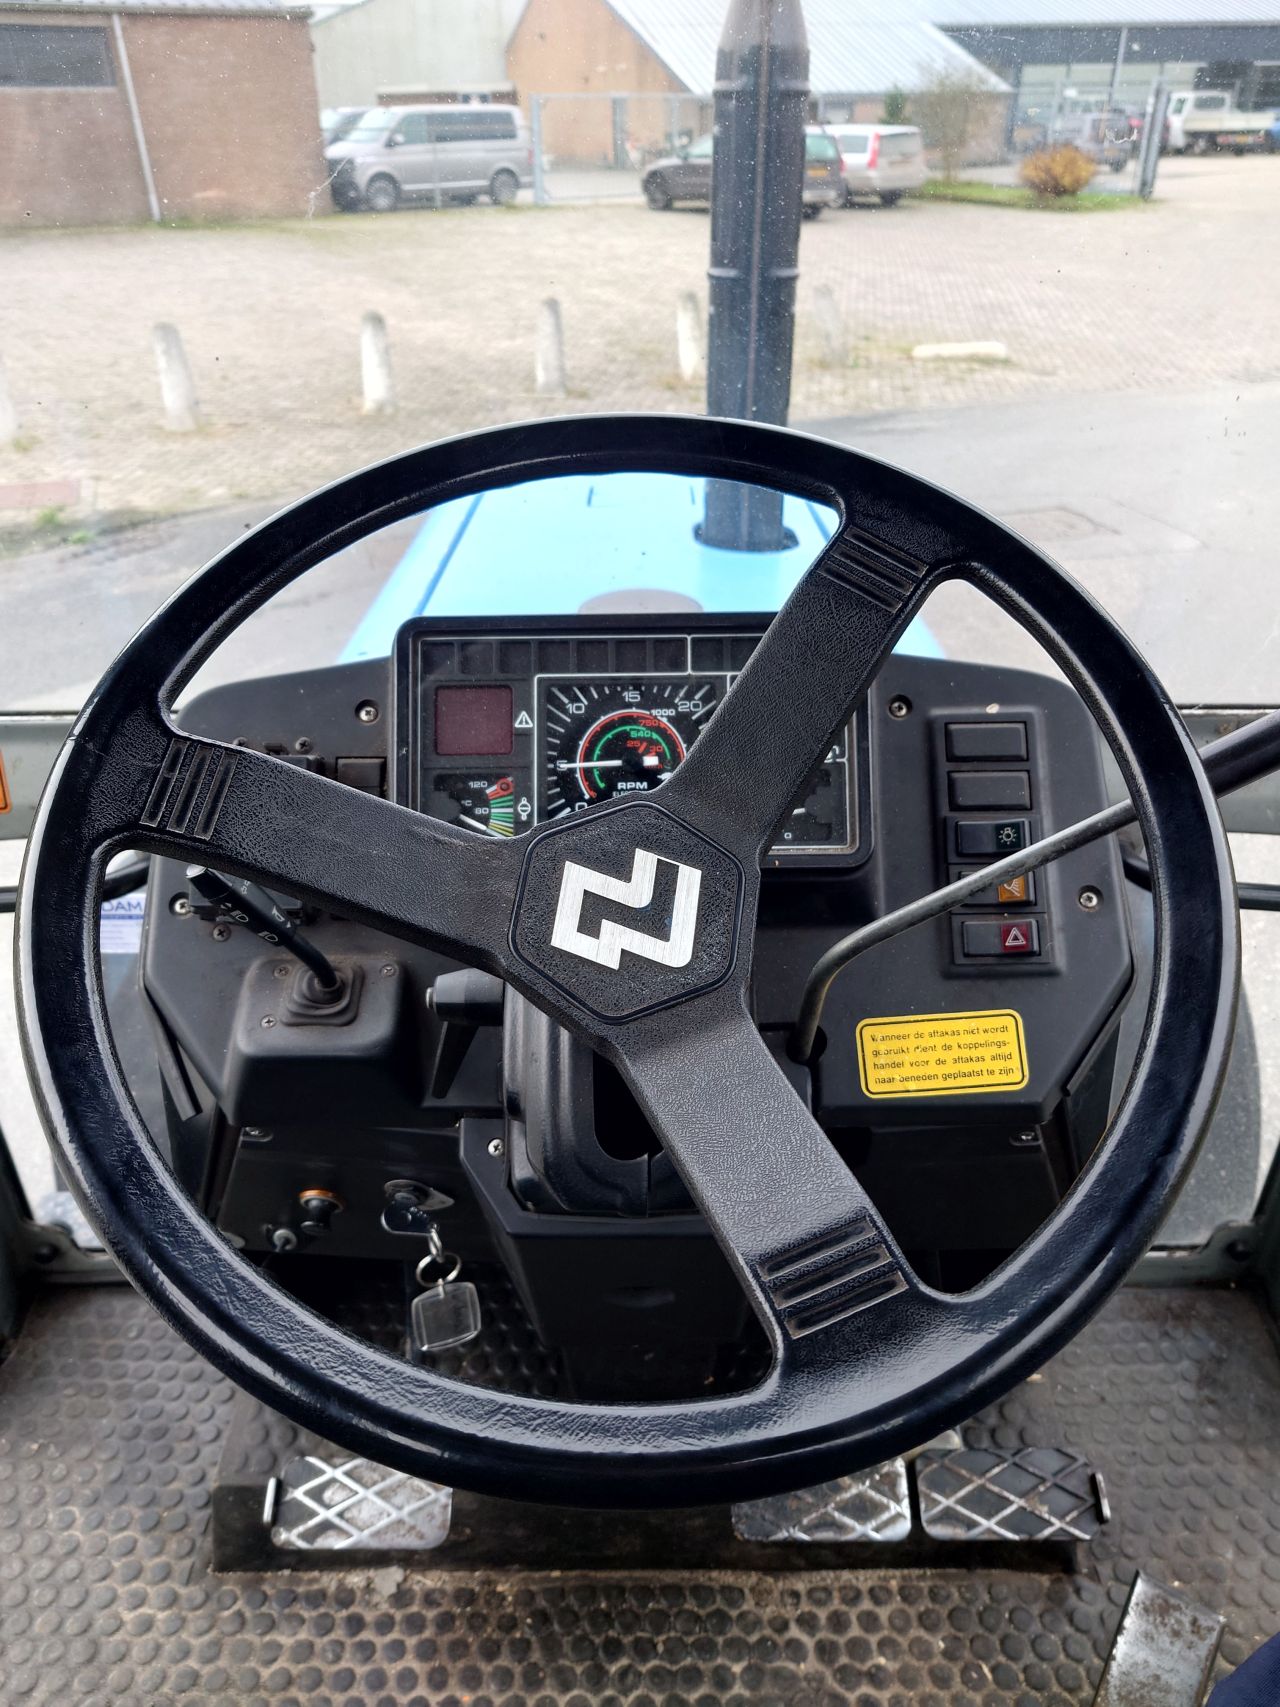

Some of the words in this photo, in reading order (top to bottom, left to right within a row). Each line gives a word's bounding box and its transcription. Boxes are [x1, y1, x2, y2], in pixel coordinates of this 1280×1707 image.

[622, 691, 641, 702] 15
[566, 703, 585, 714] 10
[678, 700, 702, 712] 20
[638, 719, 659, 727] 750
[630, 730, 651, 738] 540
[556, 760, 568, 771] 5
[617, 781, 648, 790] RPM
[982, 1025, 1008, 1034] wordt
[941, 1042, 952, 1051] de
[957, 1039, 1010, 1051] koppelings-
[873, 1060, 905, 1070] handel
[935, 1057, 946, 1066] de
[990, 1051, 1013, 1062] altijd
[875, 1076, 896, 1084] naar
[941, 1068, 983, 1081] geplaatst
[987, 1068, 996, 1076] te
[998, 1066, 1015, 1077] zijn
